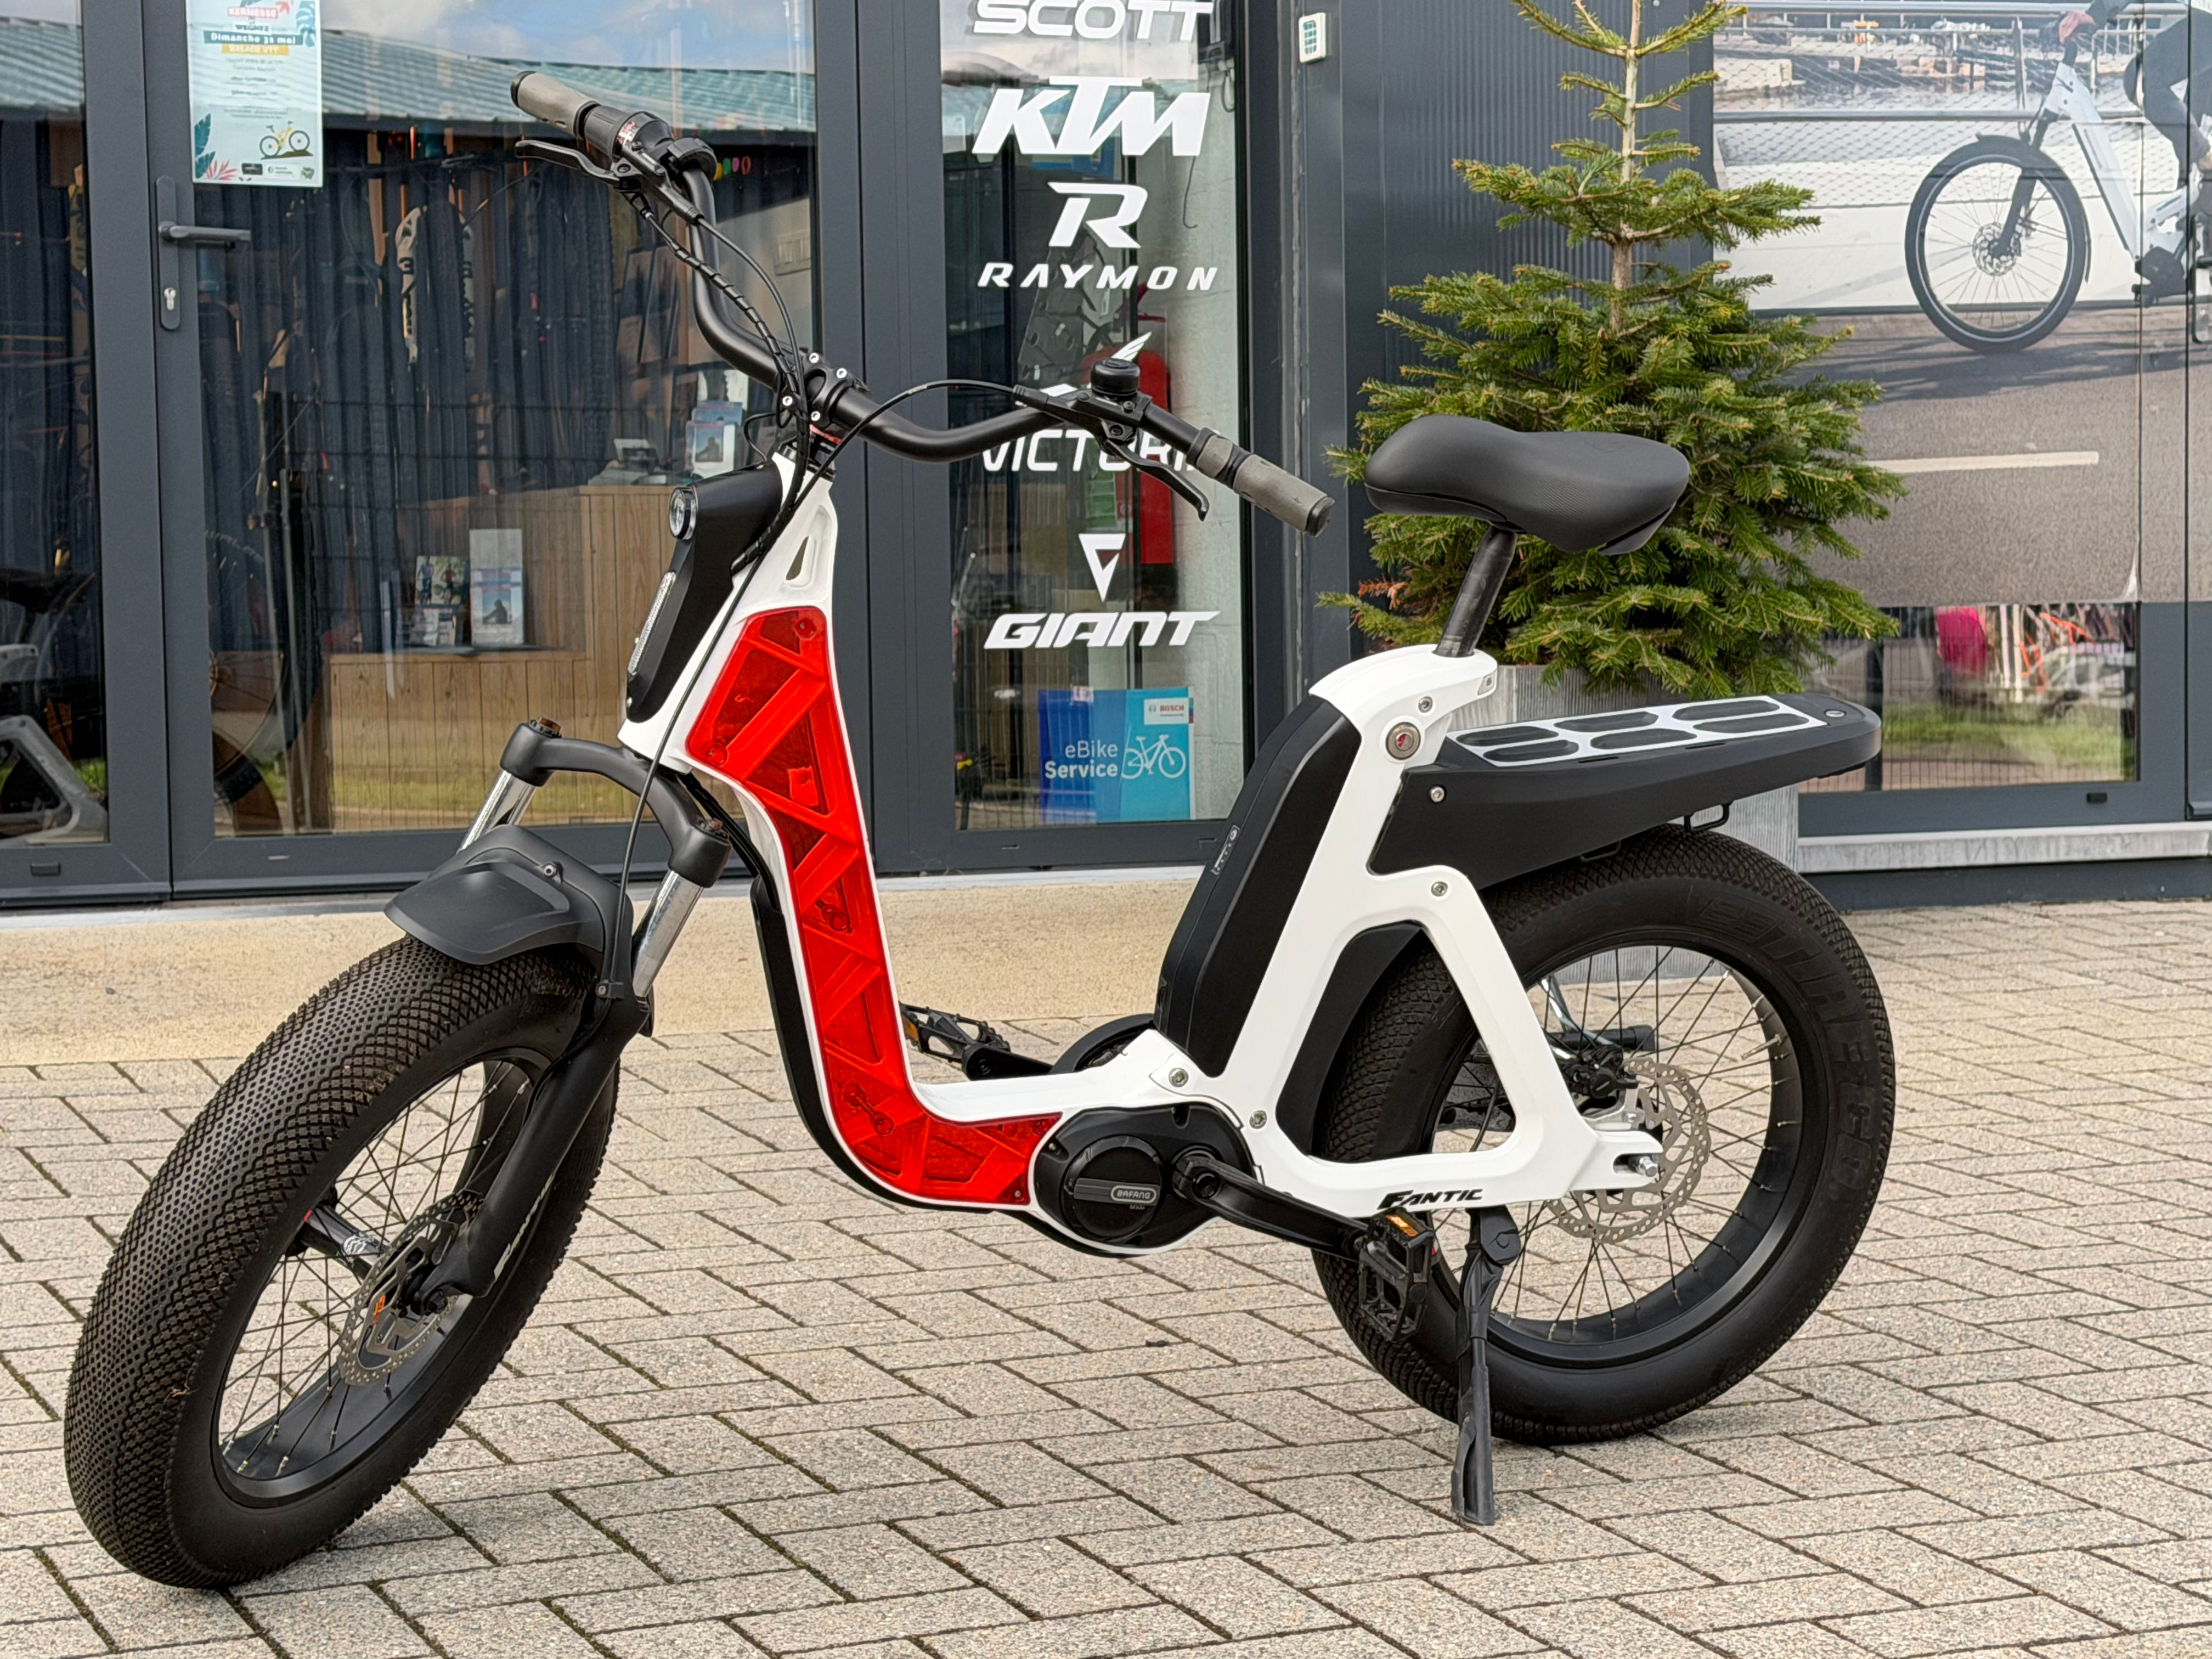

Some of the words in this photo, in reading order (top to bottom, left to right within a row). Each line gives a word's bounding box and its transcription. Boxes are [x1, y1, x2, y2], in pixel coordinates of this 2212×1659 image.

[973, 0, 1214, 41] SCOTT
[211, 32, 259, 43] Dimanche
[277, 36, 296, 44] mai
[972, 76, 1210, 156] KTM
[978, 262, 1217, 290] RAYMON
[984, 611, 1220, 649] GIANT
[1065, 739, 1118, 758] eBike
[1045, 759, 1118, 778] Service
[1117, 1189, 1151, 1199] BAFANG
[1376, 1189, 1483, 1210] FANTIC
